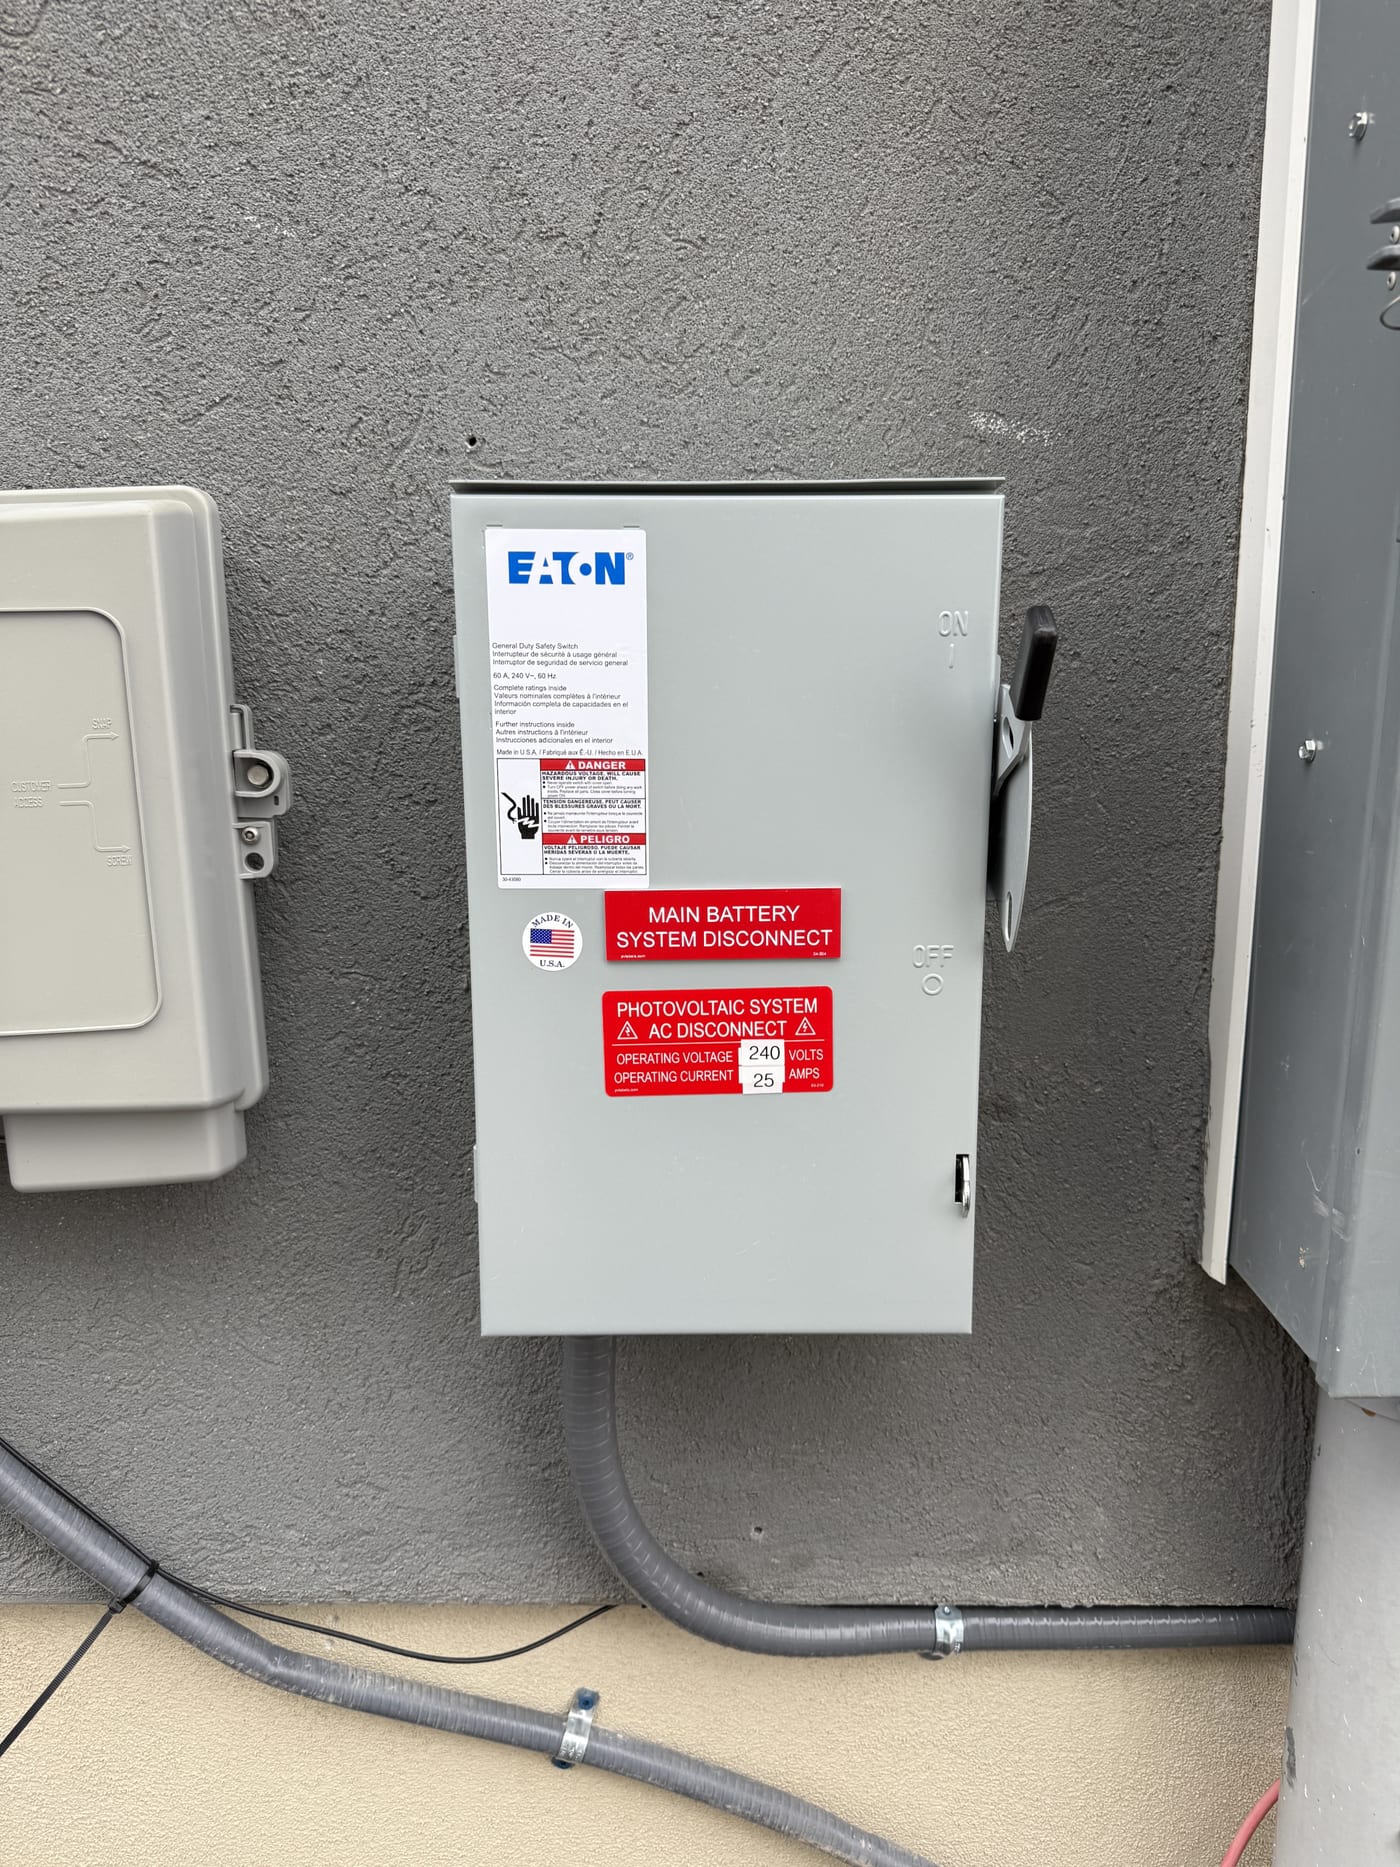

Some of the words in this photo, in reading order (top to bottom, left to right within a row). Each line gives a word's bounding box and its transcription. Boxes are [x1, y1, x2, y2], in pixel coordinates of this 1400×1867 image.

[939, 610, 968, 637] ON
[92, 718, 112, 729] SNAP
[580, 835, 630, 843] PELIGRO
[532, 914, 560, 928] MADE
[562, 918, 574, 928] IN
[649, 906, 700, 923] MAIN
[707, 905, 800, 923] BATTERY
[616, 931, 696, 947] SYSTEM
[703, 929, 832, 947] DISCONNECT
[540, 960, 566, 968] U.S.A.
[912, 944, 954, 968] OFF
[617, 1000, 744, 1018] PHOTOVOLTAIC
[750, 998, 818, 1014] SYSTEM
[649, 1023, 672, 1039] AC
[677, 1020, 787, 1038] DISCONNECT
[616, 1052, 680, 1065] OPERATING
[682, 1051, 733, 1063] VOLTAGE
[749, 1045, 781, 1060] 240
[789, 1049, 824, 1061] VOLTS
[614, 1071, 678, 1084] OPERATING
[680, 1069, 733, 1082] CURRENT
[753, 1073, 774, 1088] 25
[789, 1068, 820, 1080] AMPS
